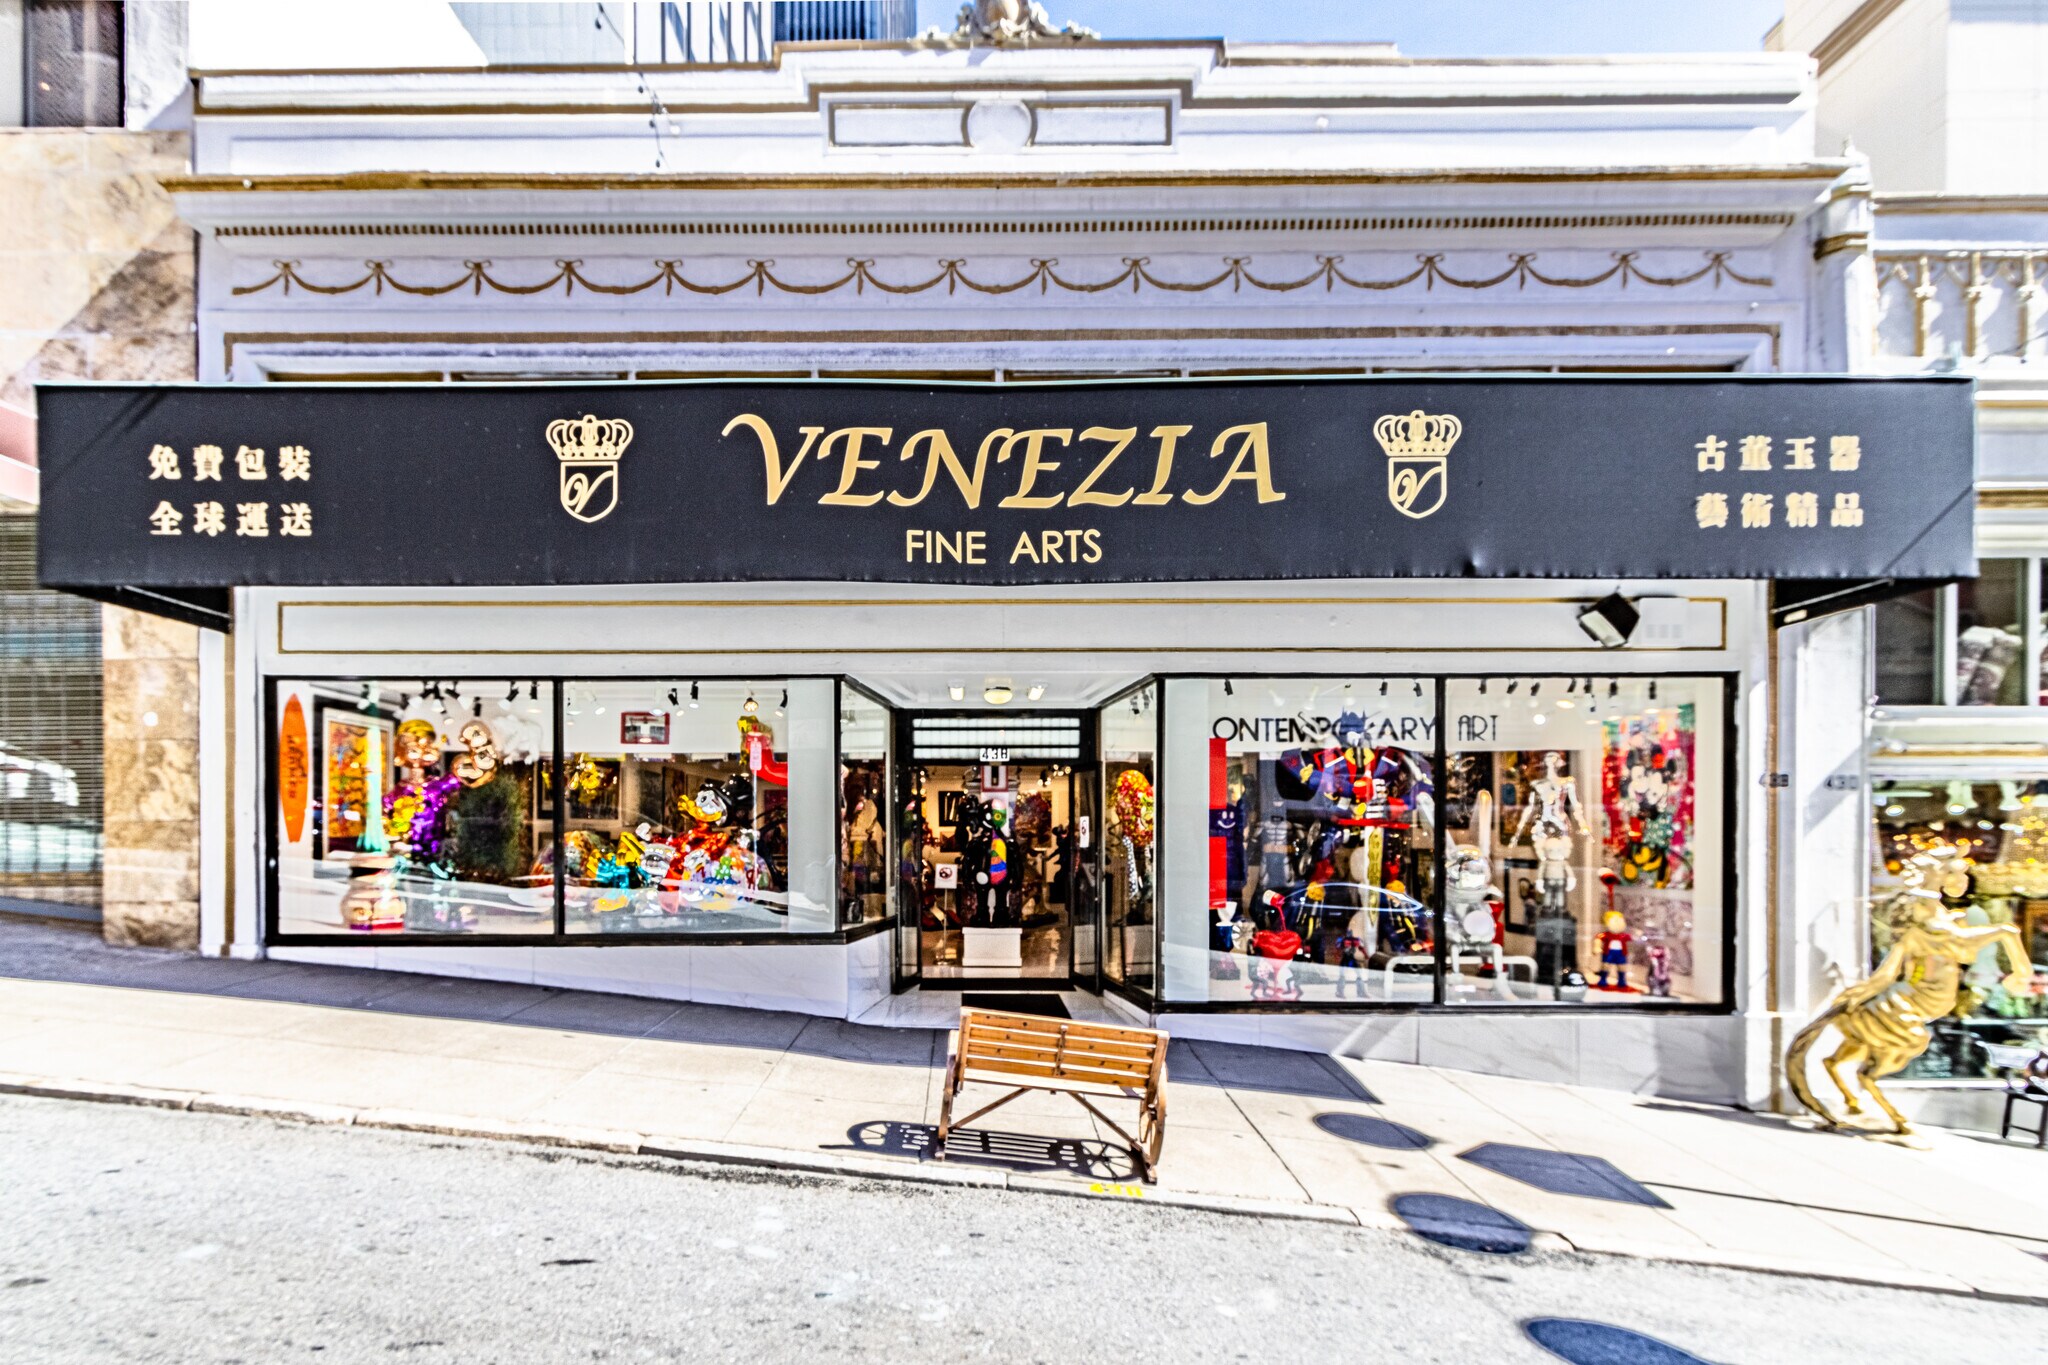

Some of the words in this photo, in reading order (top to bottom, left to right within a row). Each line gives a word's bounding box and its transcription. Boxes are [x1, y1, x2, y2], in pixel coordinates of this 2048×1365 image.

[148, 444, 311, 481] 免費包裝
[722, 413, 1286, 510] VENEZIA
[1695, 435, 1861, 471] 古董玉器
[149, 500, 313, 537] 全球運送
[1696, 492, 1864, 528] 藝術精品
[906, 529, 987, 565] FINE
[1009, 528, 1103, 564] ARTS
[1458, 715, 1499, 742] ART
